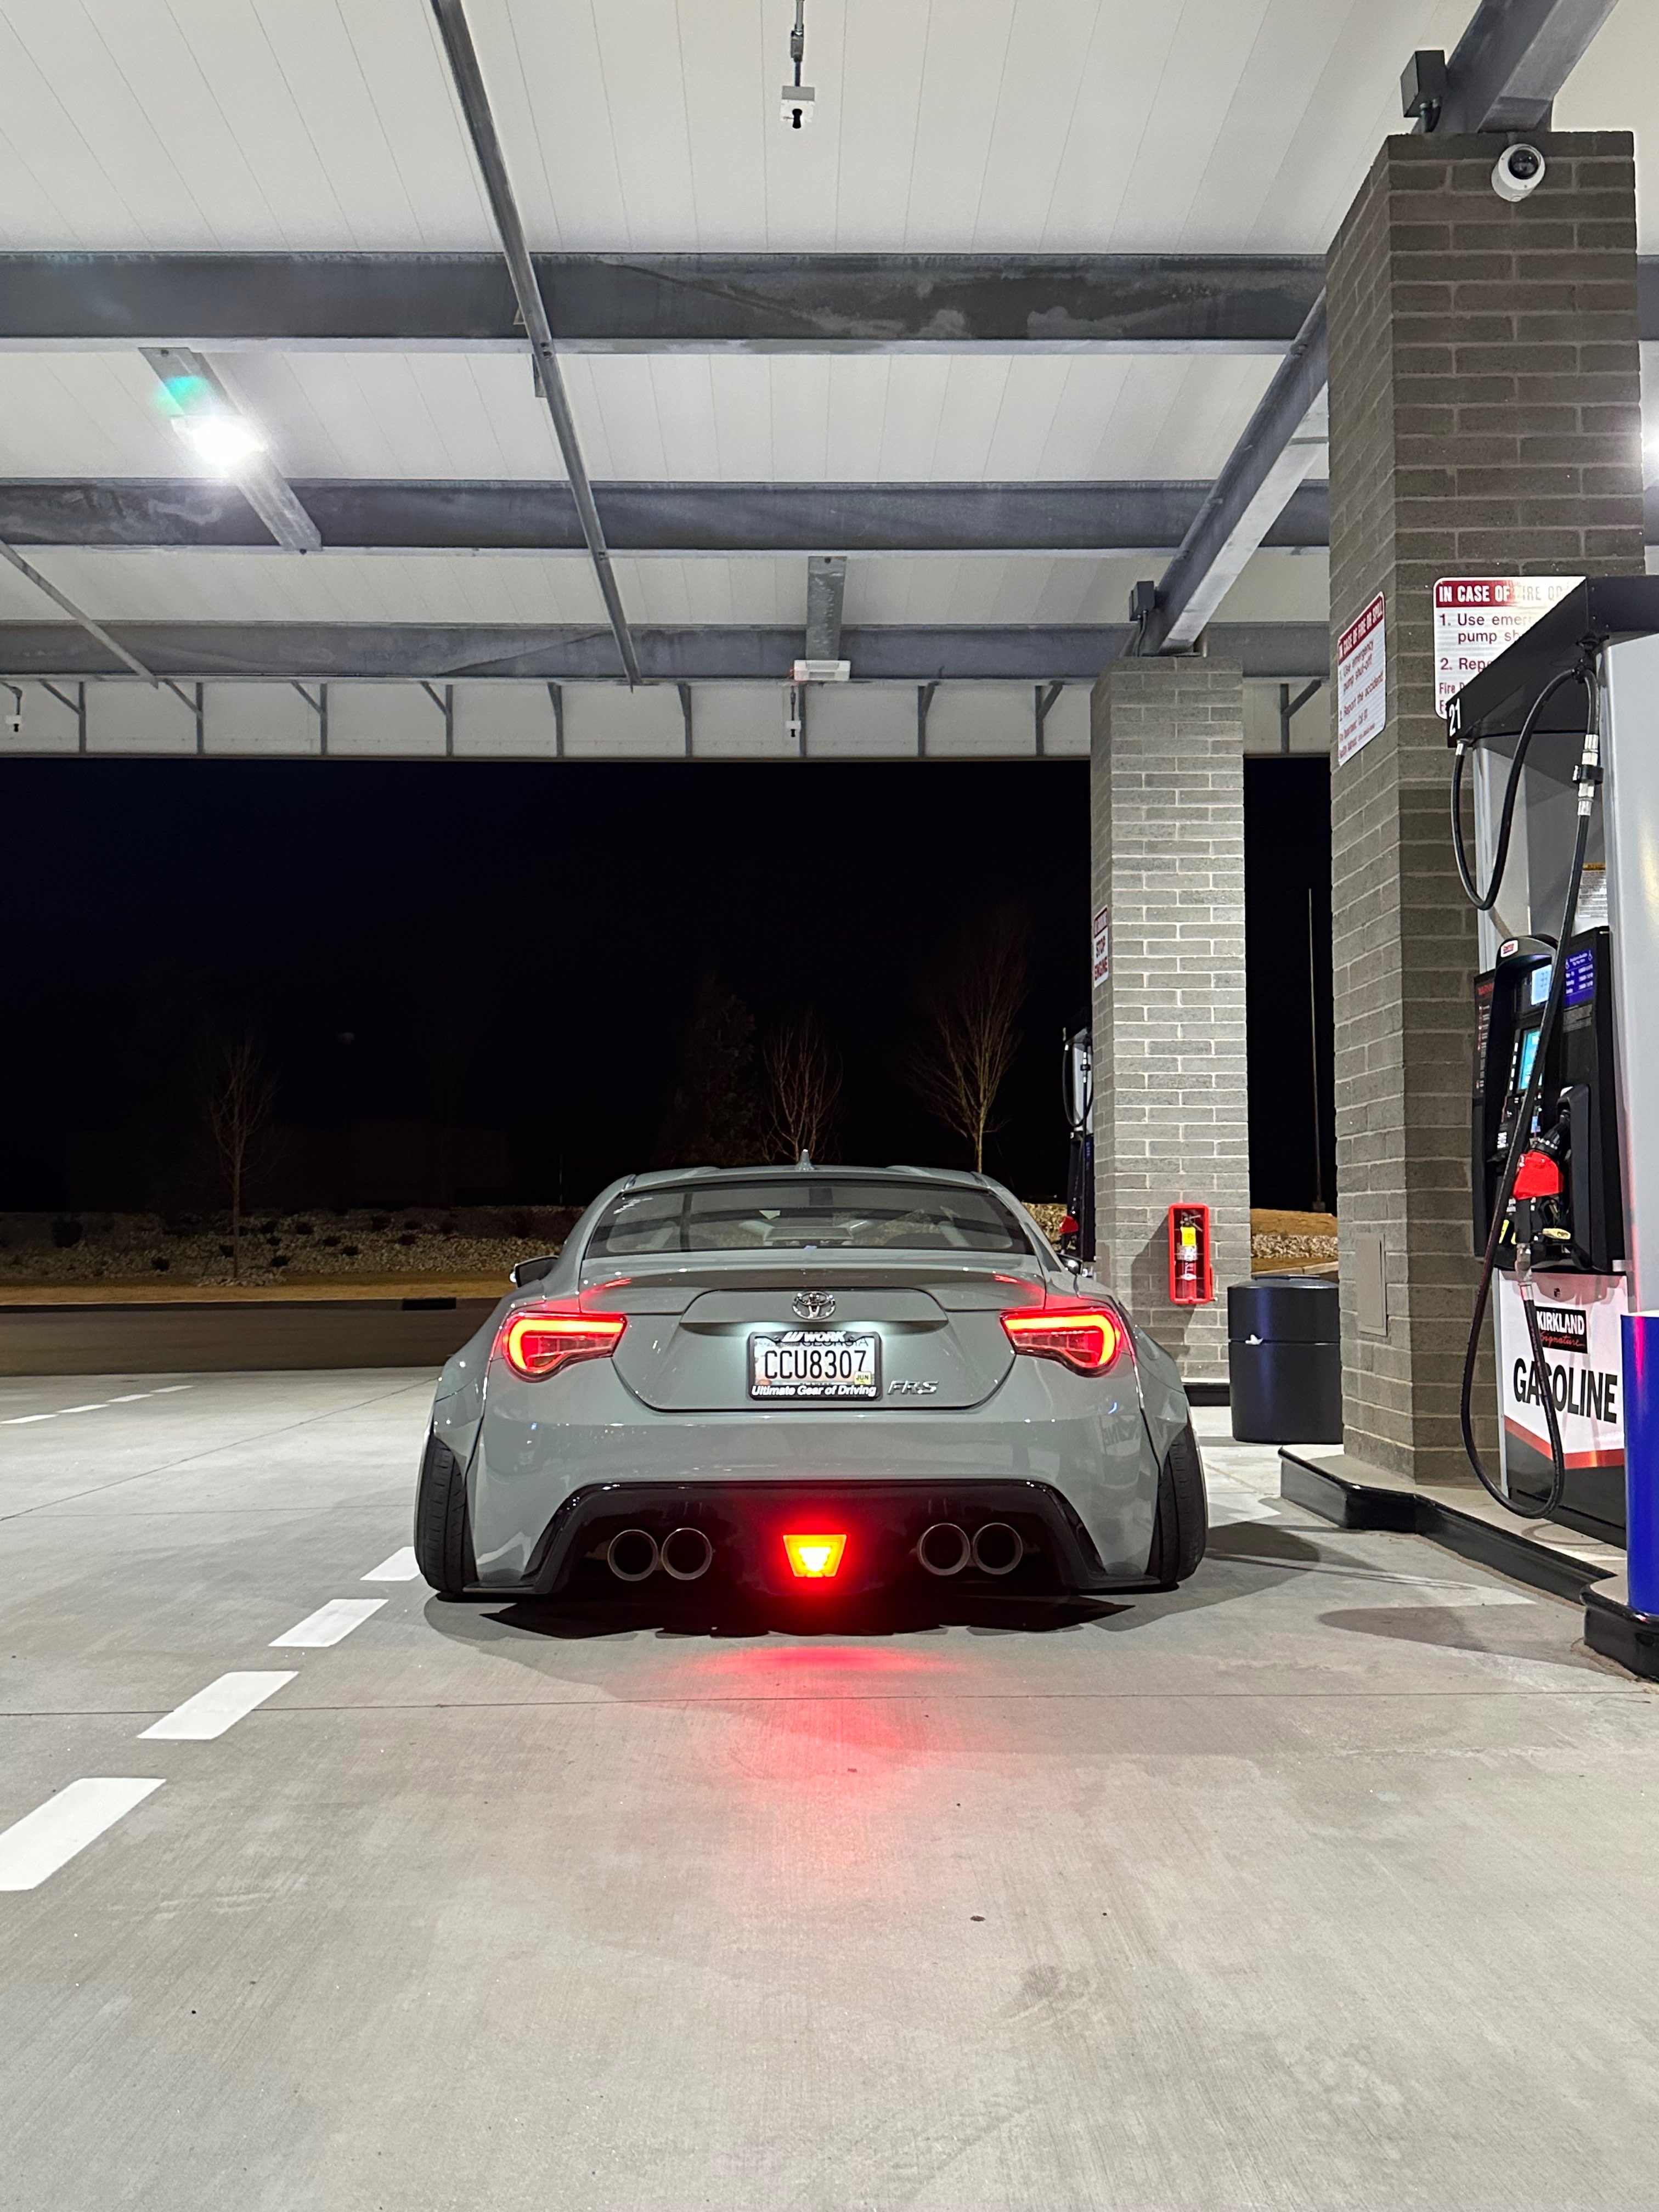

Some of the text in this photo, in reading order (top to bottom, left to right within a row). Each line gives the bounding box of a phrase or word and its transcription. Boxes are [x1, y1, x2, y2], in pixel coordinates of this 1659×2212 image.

[1439, 586, 1453, 602] IN
[1457, 585, 1491, 602] CASE
[1494, 585, 1510, 601] OF
[1440, 613, 1451, 626] 1.
[1458, 613, 1485, 626] Use
[1458, 632, 1497, 644] pump
[1440, 658, 1452, 670] 2.
[1440, 682, 1455, 694] Fire
[1449, 698, 1461, 737] 21
[1536, 1310, 1585, 1335] KIRKLAND
[804, 1331, 846, 1342] WORK
[764, 1350, 867, 1379] CCU8307
[751, 1385, 877, 1397] Ultimate Gear of Driving
